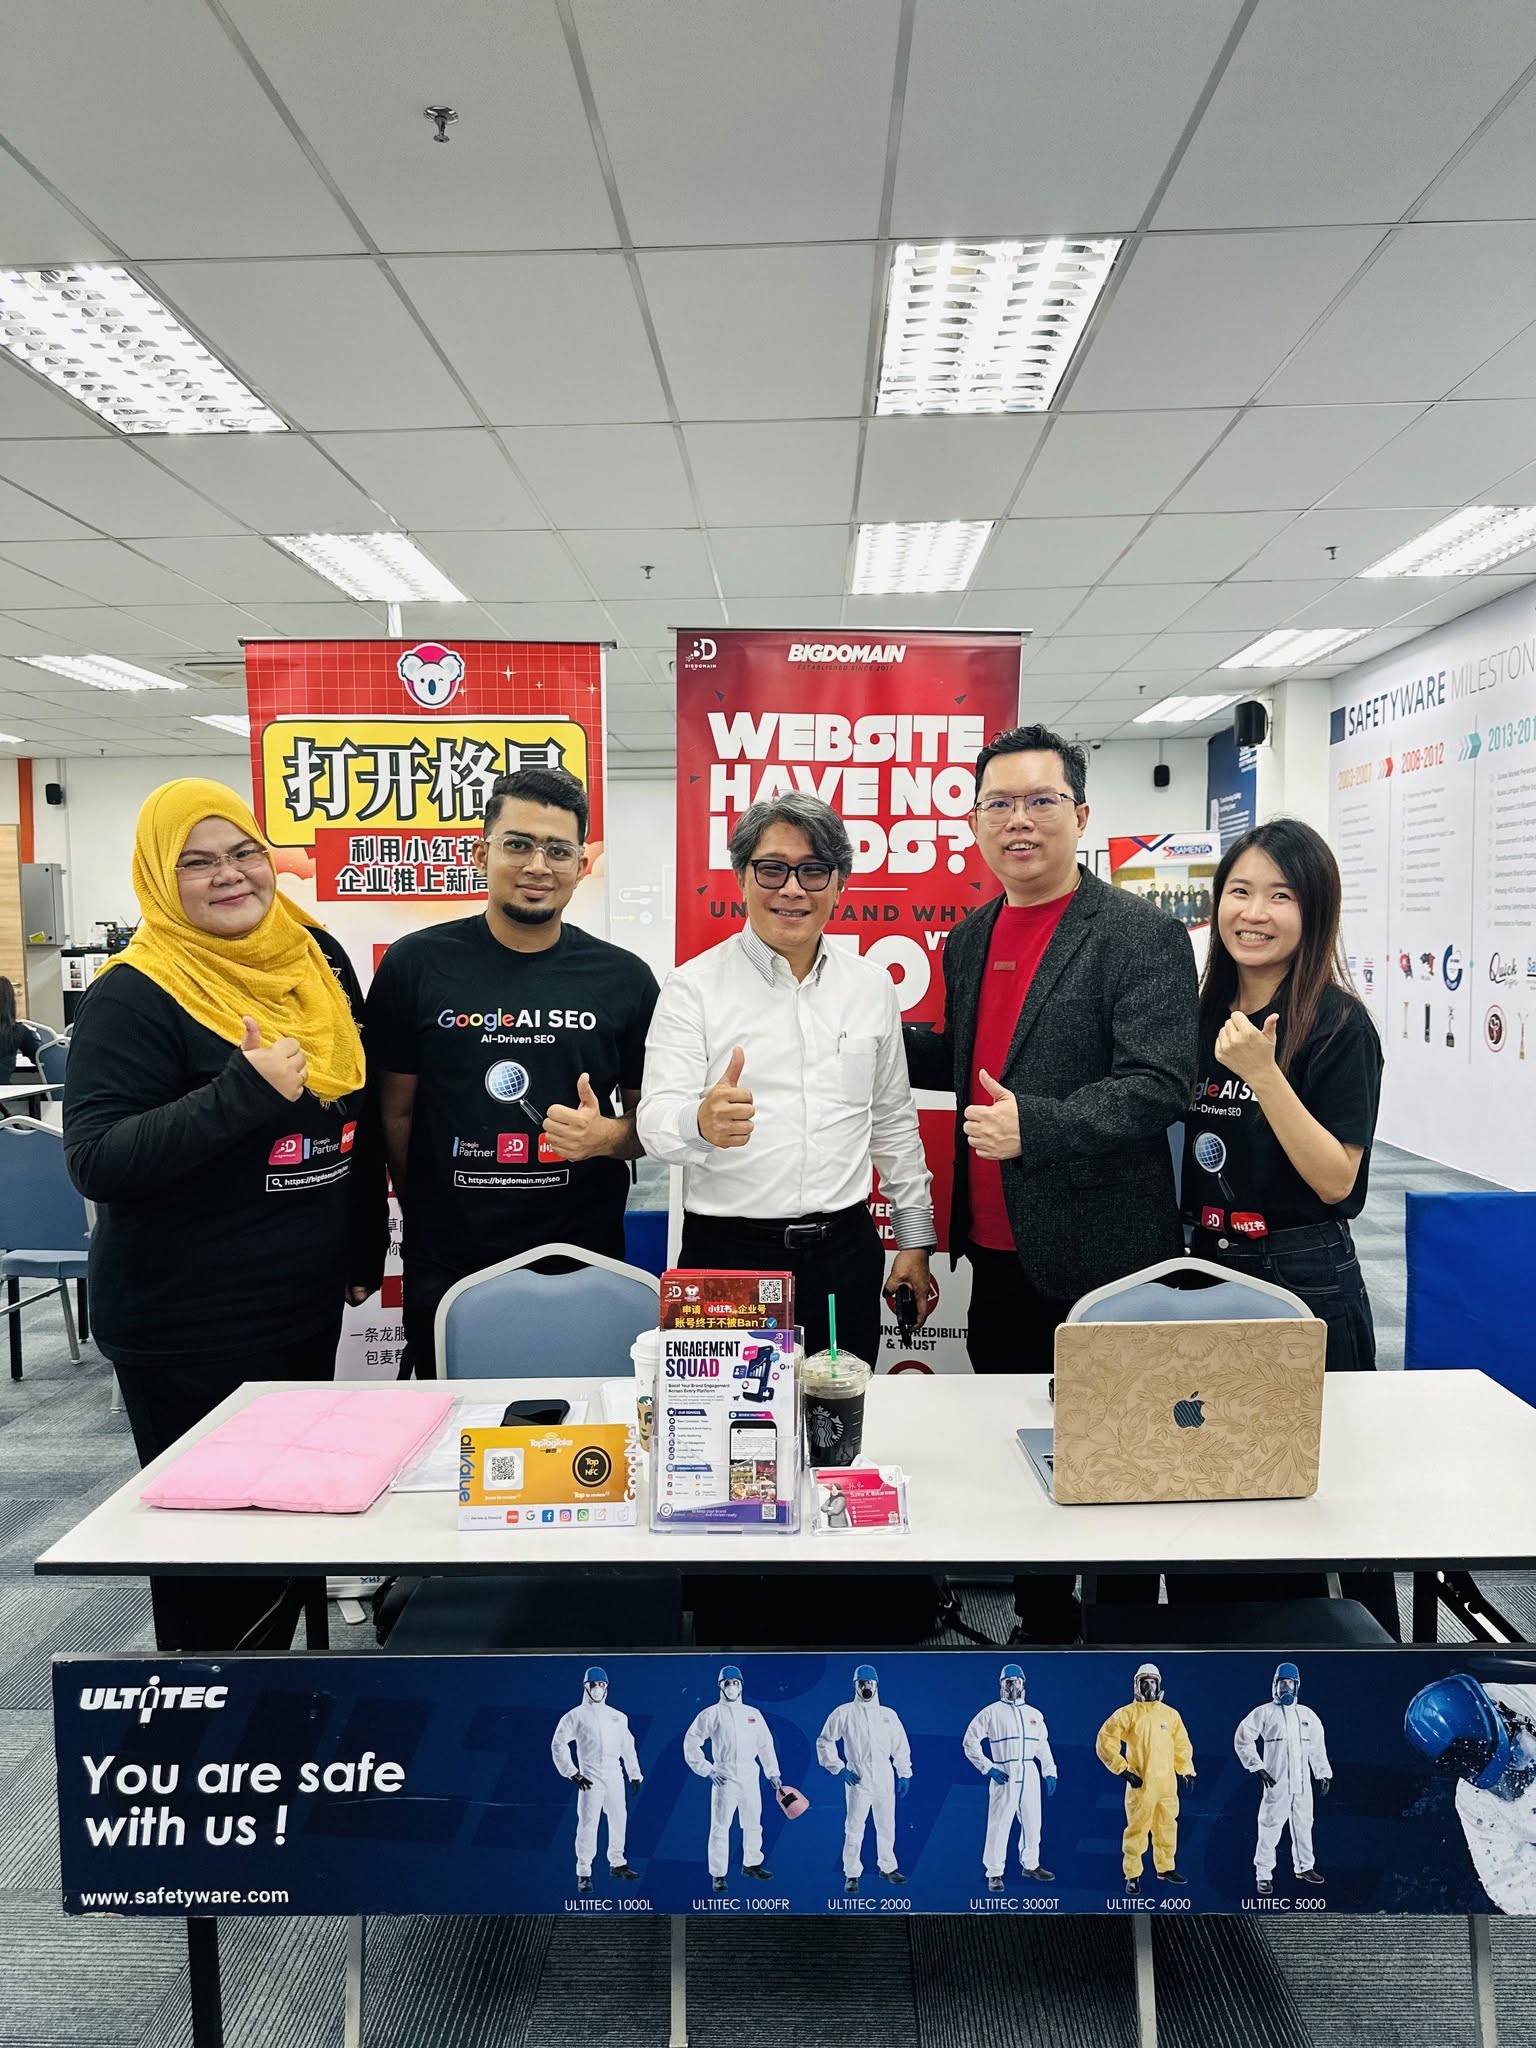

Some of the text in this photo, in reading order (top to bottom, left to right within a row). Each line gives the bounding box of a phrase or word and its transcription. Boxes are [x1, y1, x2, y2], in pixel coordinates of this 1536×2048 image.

[787, 643, 907, 663] BIGDOMAIN
[1348, 670, 1446, 737] SAFETYWARE
[707, 711, 985, 763] WEBSITE
[1401, 742, 1444, 774] 2008-2012
[709, 763, 977, 817] HAVE NO
[708, 816, 978, 875] LDS?
[710, 901, 900, 922] UNTAND
[547, 1009, 597, 1030] SEO
[480, 1034, 556, 1044] AI-Driven SEO
[1188, 1104, 1242, 1117] AI-Driven SEO
[311, 1142, 340, 1155] Partner
[460, 1140, 479, 1149] Google
[459, 1147, 495, 1158] Partner
[468, 1176, 560, 1186] https://bigdomain.my/seo
[738, 1304, 767, 1315] 企业号
[911, 1327, 969, 1339] REDIBILIT
[665, 1341, 741, 1357] ENGAGEMENT
[886, 1339, 896, 1349] &
[665, 1358, 720, 1379] SQUAD
[584, 1468, 599, 1476] NFC
[79, 1675, 228, 1723] ULTITEC
[82, 1751, 405, 1795] You are safe
[85, 1805, 288, 1847] with us !
[80, 1887, 289, 1908] www.safetyware.com
[564, 1898, 653, 1911] ULTITEC 1000L
[692, 1898, 790, 1911] ULTITEC 1000FR
[827, 1898, 912, 1911] ULTITEC 2000
[969, 1898, 1060, 1911] ULTITEC 3000T
[1106, 1898, 1191, 1911] ULTITEC 4000
[1241, 1898, 1326, 1911] ULTITEC 5000
